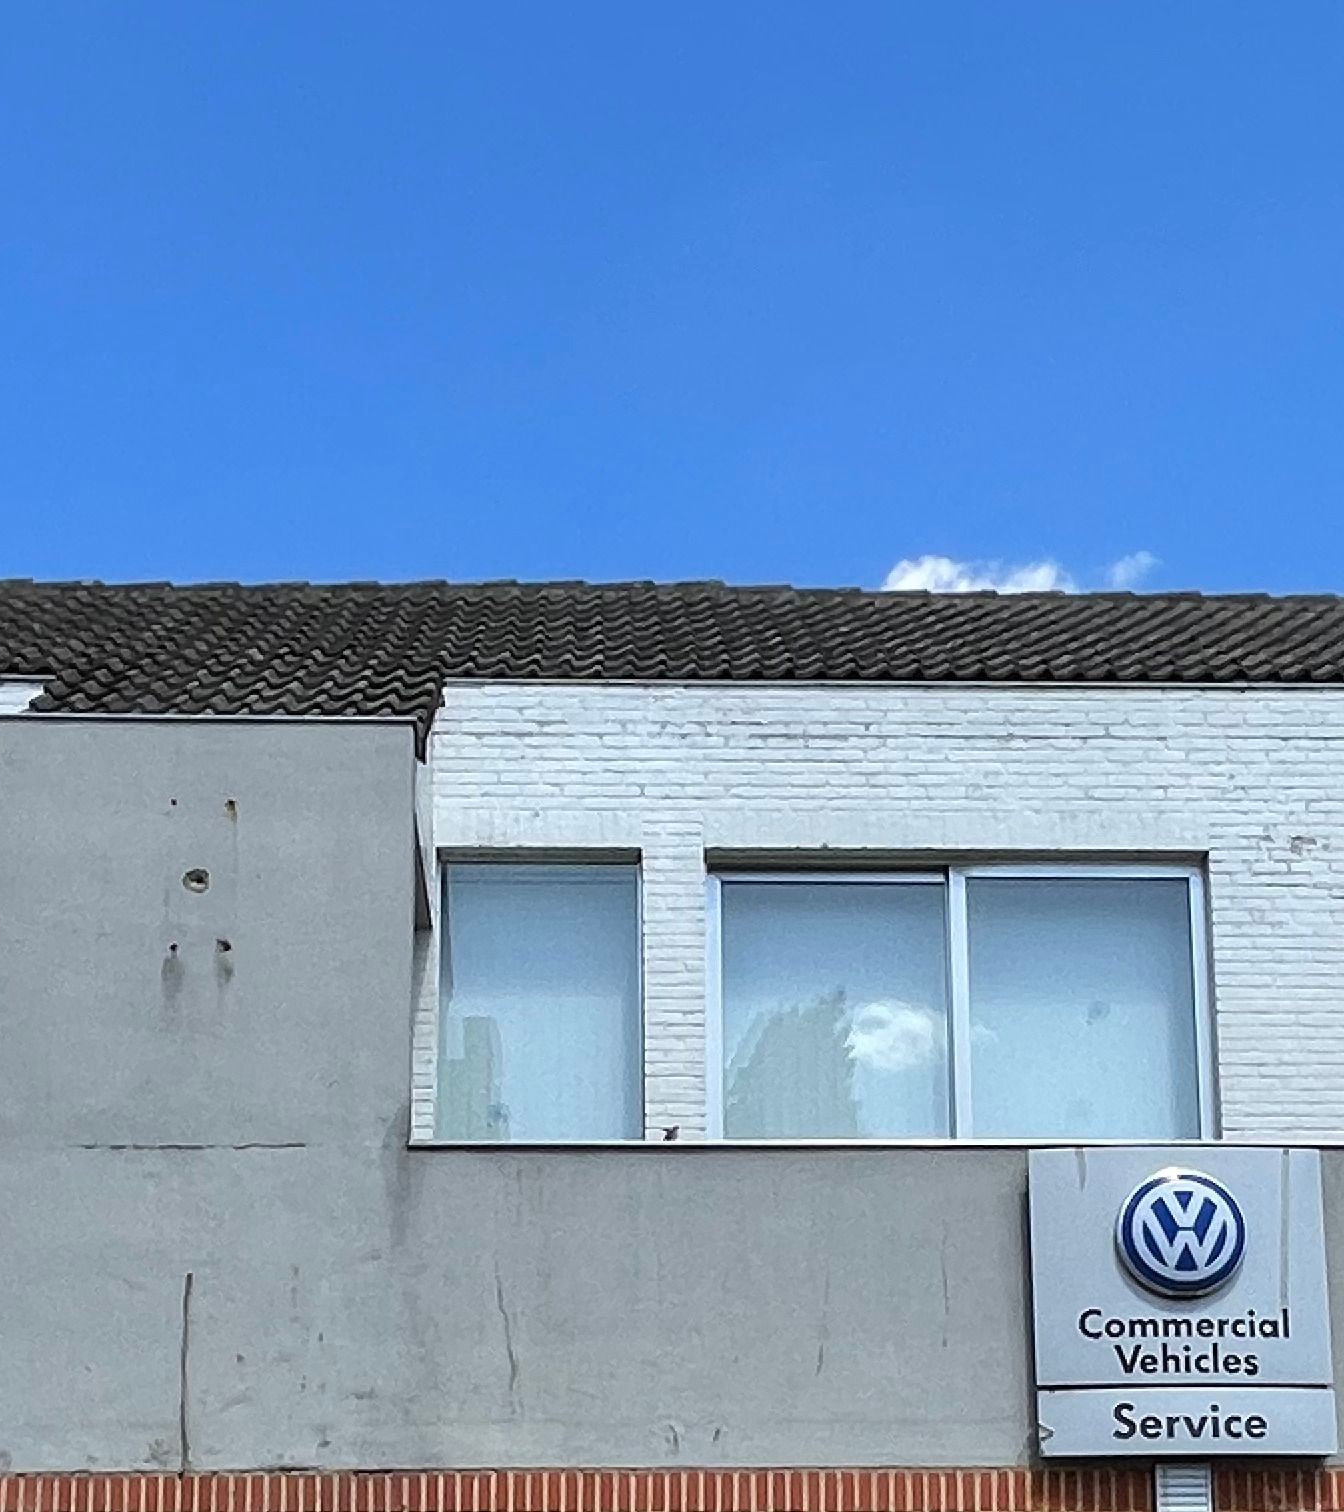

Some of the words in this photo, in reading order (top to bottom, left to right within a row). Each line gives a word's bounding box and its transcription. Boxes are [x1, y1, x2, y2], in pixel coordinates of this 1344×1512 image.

[1078, 1308, 1291, 1340] Commercial
[1113, 1342, 1259, 1376] Vehicles
[1112, 1402, 1268, 1440] Service
